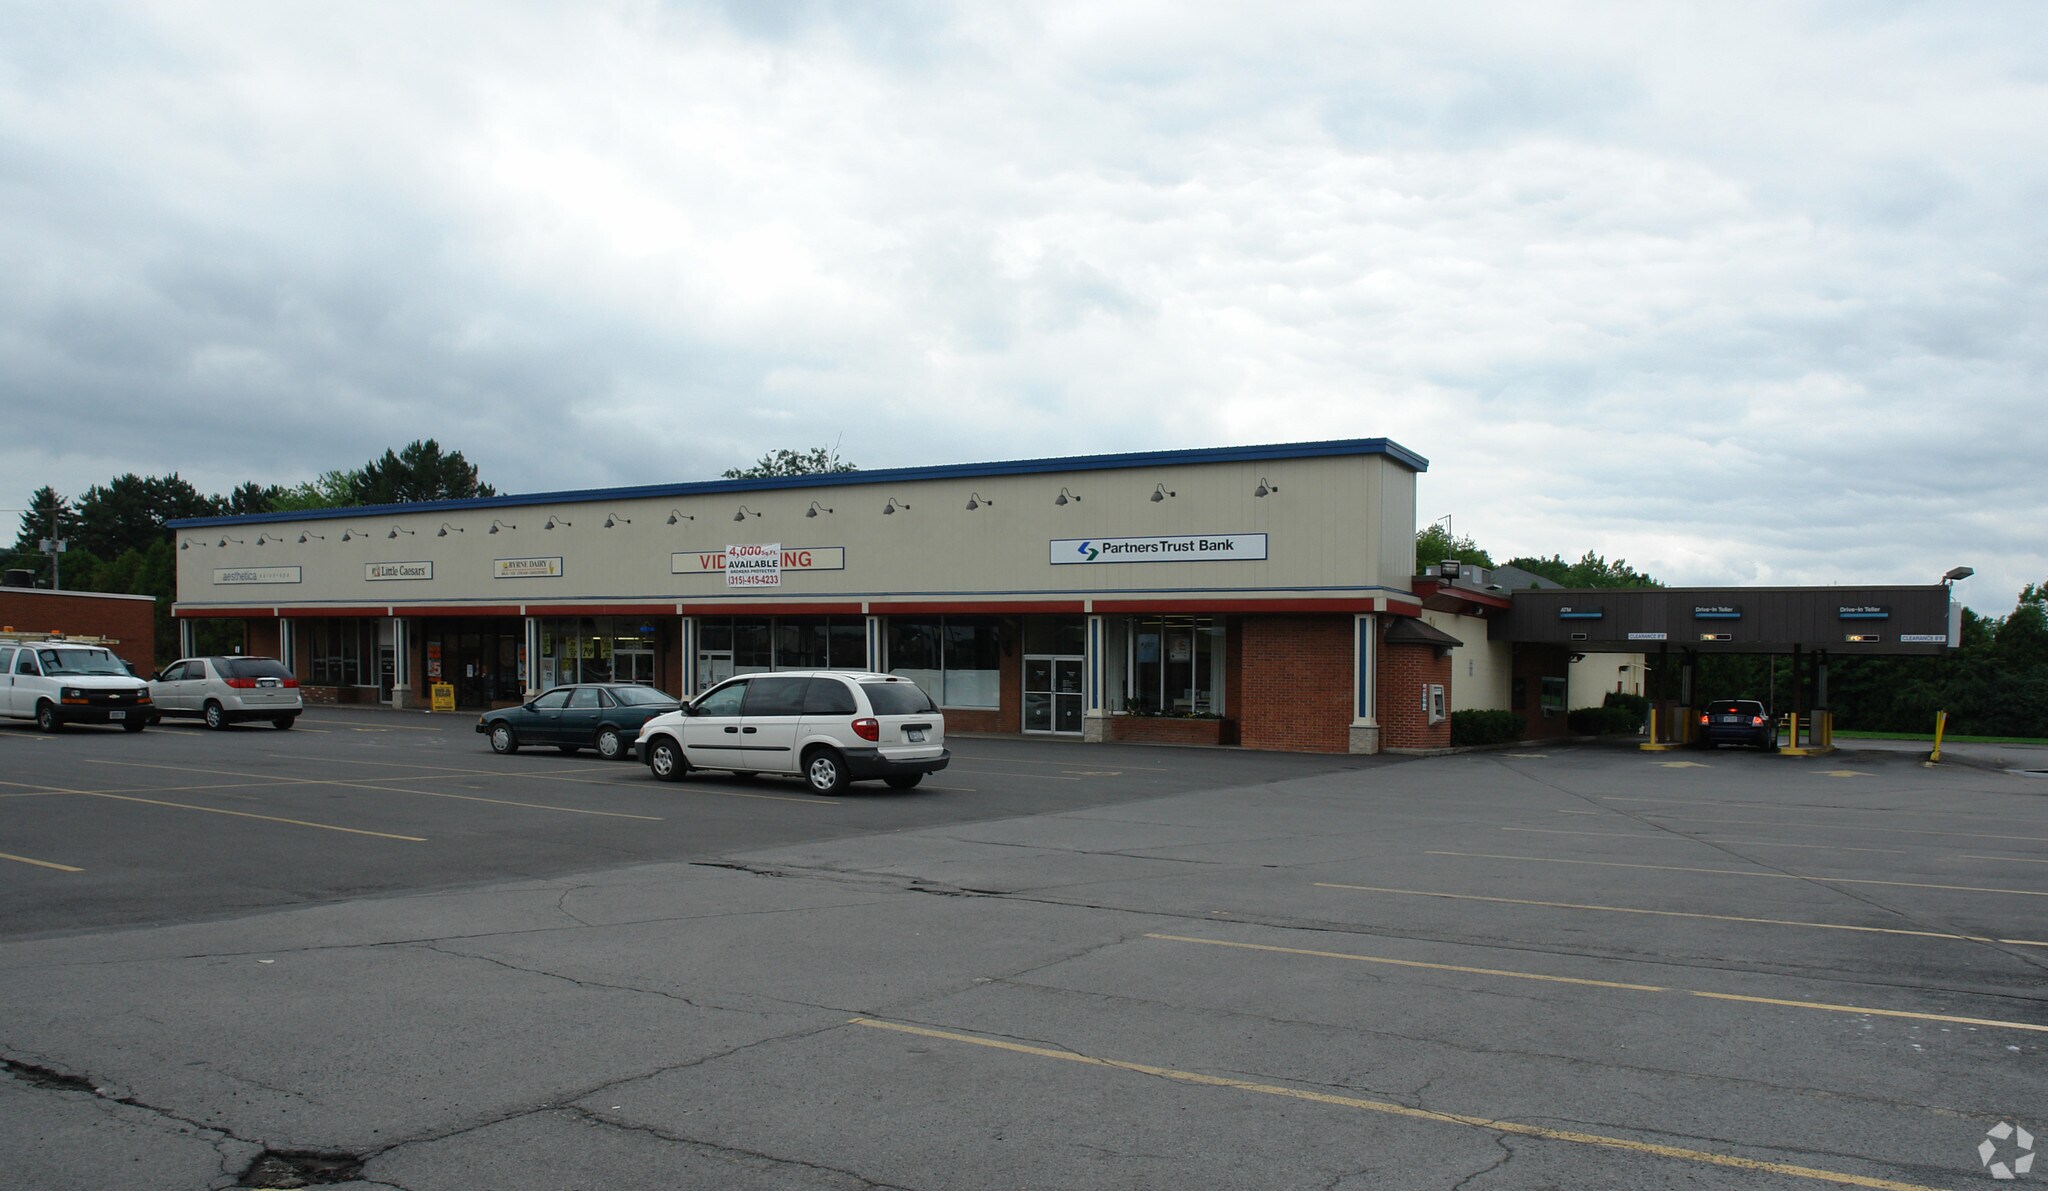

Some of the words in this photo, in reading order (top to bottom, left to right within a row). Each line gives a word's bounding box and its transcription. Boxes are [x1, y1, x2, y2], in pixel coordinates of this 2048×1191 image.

[729, 546, 761, 558] 4,000
[1102, 542, 1158, 554] Partners
[1159, 540, 1195, 552] Trust
[1199, 539, 1234, 551] Bank
[508, 561, 528, 569] BYRNE
[529, 560, 547, 568] DAIRY
[728, 559, 778, 569] AVAILABLE
[780, 551, 812, 567] ING
[222, 569, 257, 581] aesthetica
[381, 565, 398, 577] Little
[399, 565, 425, 576] Caesars
[728, 575, 779, 586] (315)-415-4233
